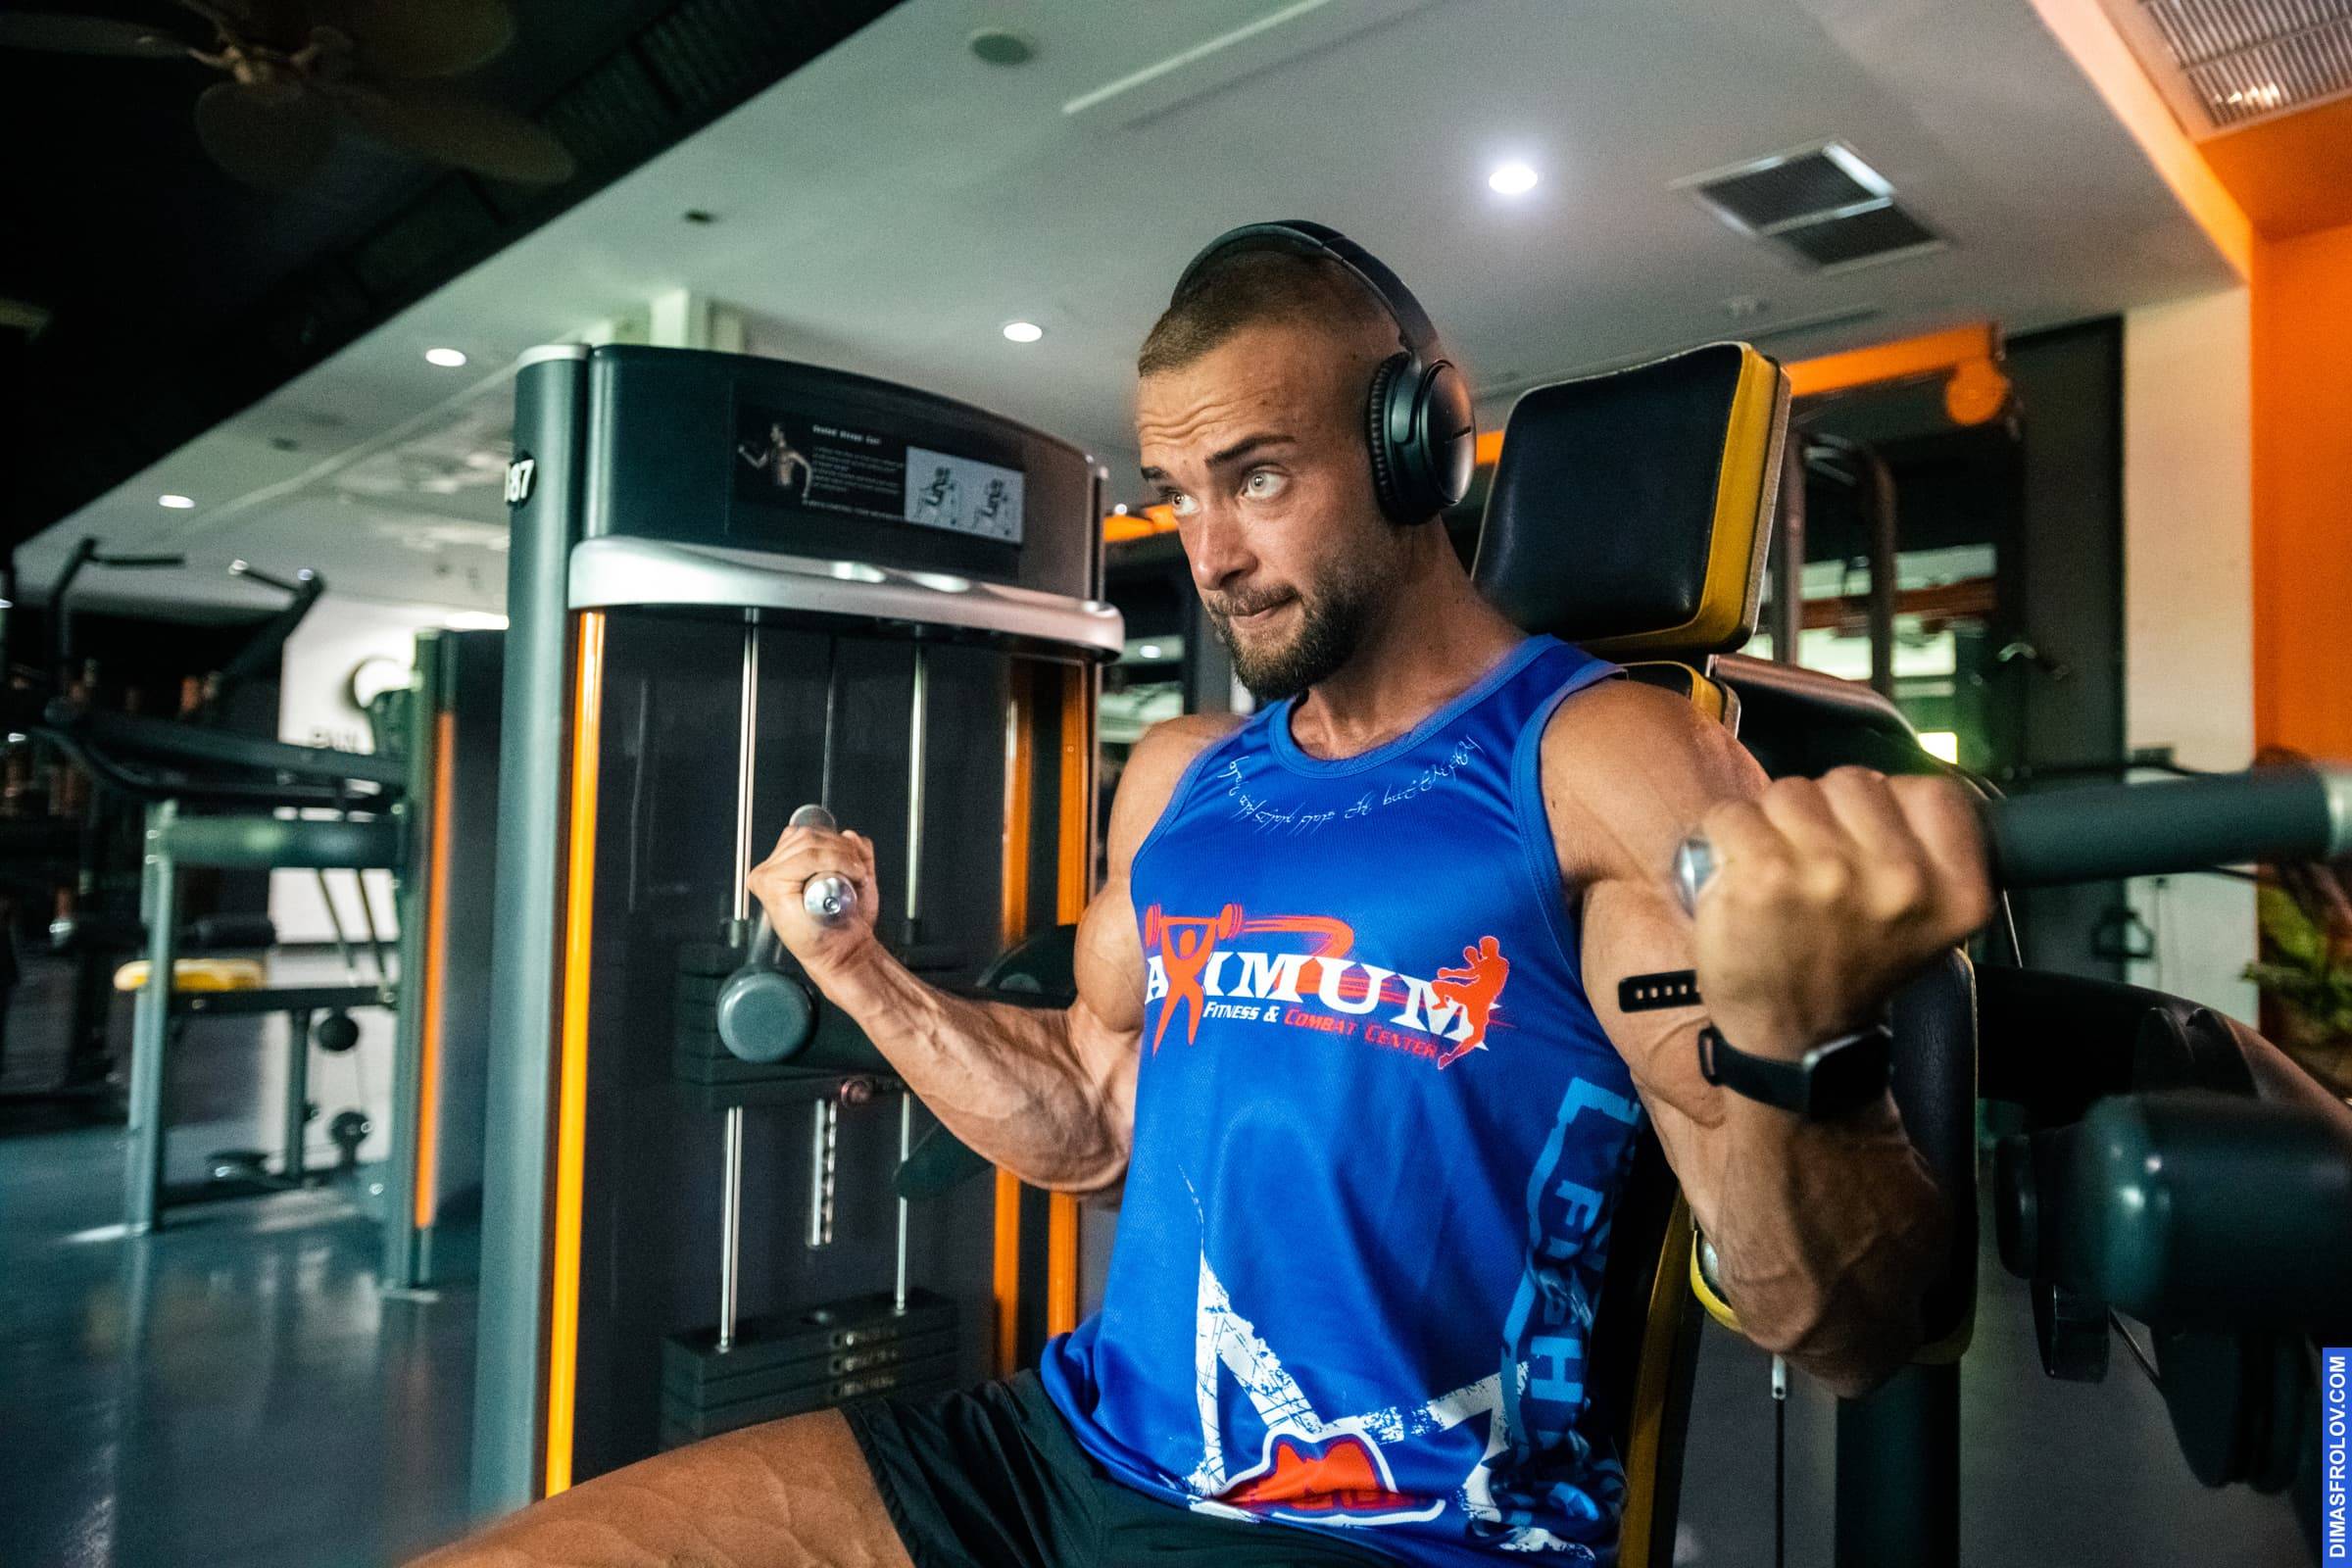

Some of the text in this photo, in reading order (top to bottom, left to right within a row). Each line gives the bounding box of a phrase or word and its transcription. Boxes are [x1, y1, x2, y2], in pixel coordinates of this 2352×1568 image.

[1202, 1001, 1440, 1059] FITNESS & COMBAT CENTER
